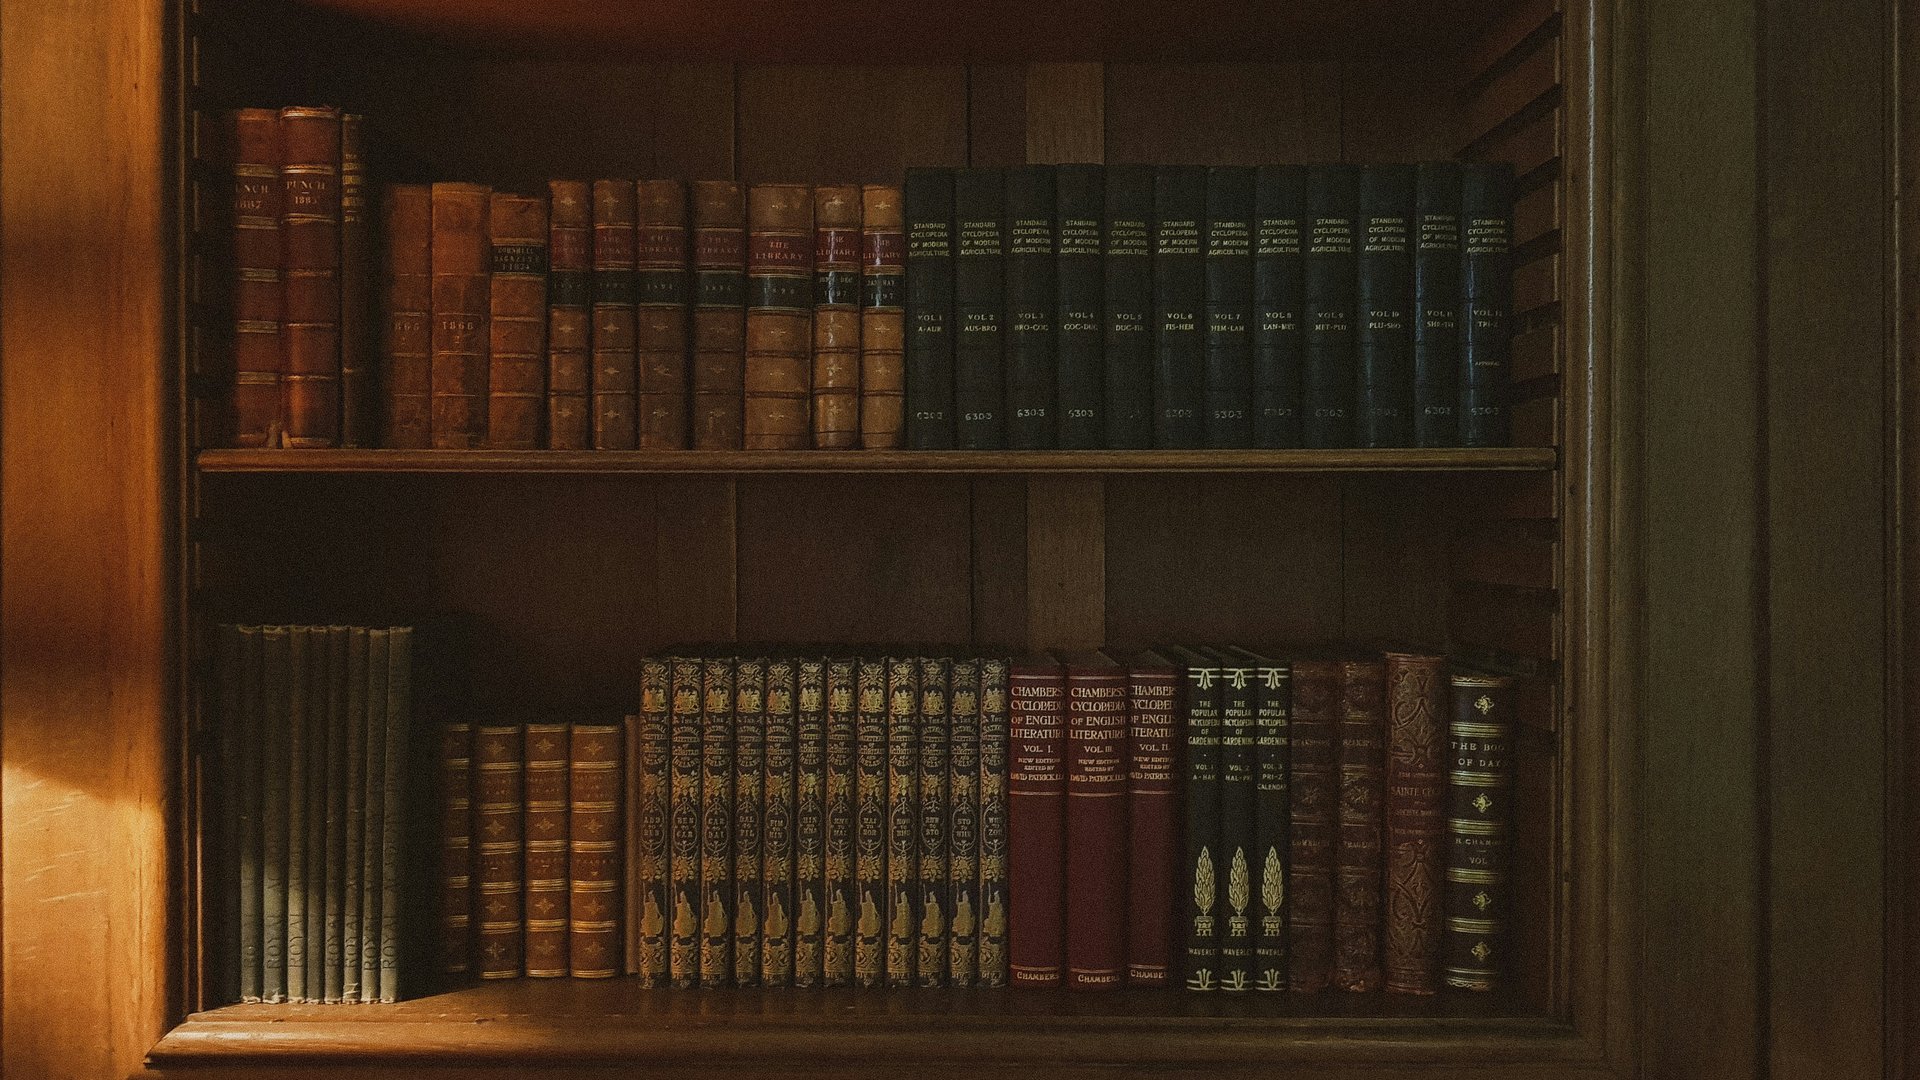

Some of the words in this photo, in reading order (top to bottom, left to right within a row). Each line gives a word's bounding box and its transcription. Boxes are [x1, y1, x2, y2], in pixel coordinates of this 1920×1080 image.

[913, 222, 947, 230] STANDARD
[963, 221, 997, 229] STANDARD
[1259, 237, 1269, 245] OF
[1313, 236, 1322, 244] OF
[1368, 236, 1378, 244] OF
[1422, 233, 1432, 241] OF
[910, 241, 920, 249] OF
[1062, 237, 1072, 246] OF
[1210, 239, 1220, 247] OF
[756, 252, 803, 260] LIBRARY
[967, 313, 988, 321] VOL
[1068, 311, 1089, 319] VOL
[1166, 311, 1187, 320] VOL
[1265, 311, 1286, 319] VOL
[1369, 309, 1389, 318] VOL
[1390, 310, 1401, 318] 10
[964, 412, 993, 421] 6303
[1017, 409, 1045, 417] 6303
[1198, 700, 1212, 708] THE
[1232, 700, 1246, 708] THE
[1266, 700, 1280, 708] THE
[1190, 708, 1219, 717] POPULAR
[1224, 708, 1252, 717] POPULAR
[1258, 708, 1287, 717] POPULAR
[1011, 717, 1023, 725] OF
[1070, 717, 1084, 726] OF
[1086, 717, 1125, 726] ENGLISH
[1070, 730, 1125, 739] LITERATURE
[1452, 741, 1477, 751] THE
[1483, 743, 1506, 752] BOO
[1017, 756, 1035, 764] NEW
[1077, 758, 1095, 766] NEW
[1133, 755, 1150, 763] NEW
[1458, 758, 1473, 766] OF
[1010, 772, 1028, 781] DAVID
[1069, 774, 1088, 783] DAVID
[1017, 972, 1059, 980] CHAMBERS
